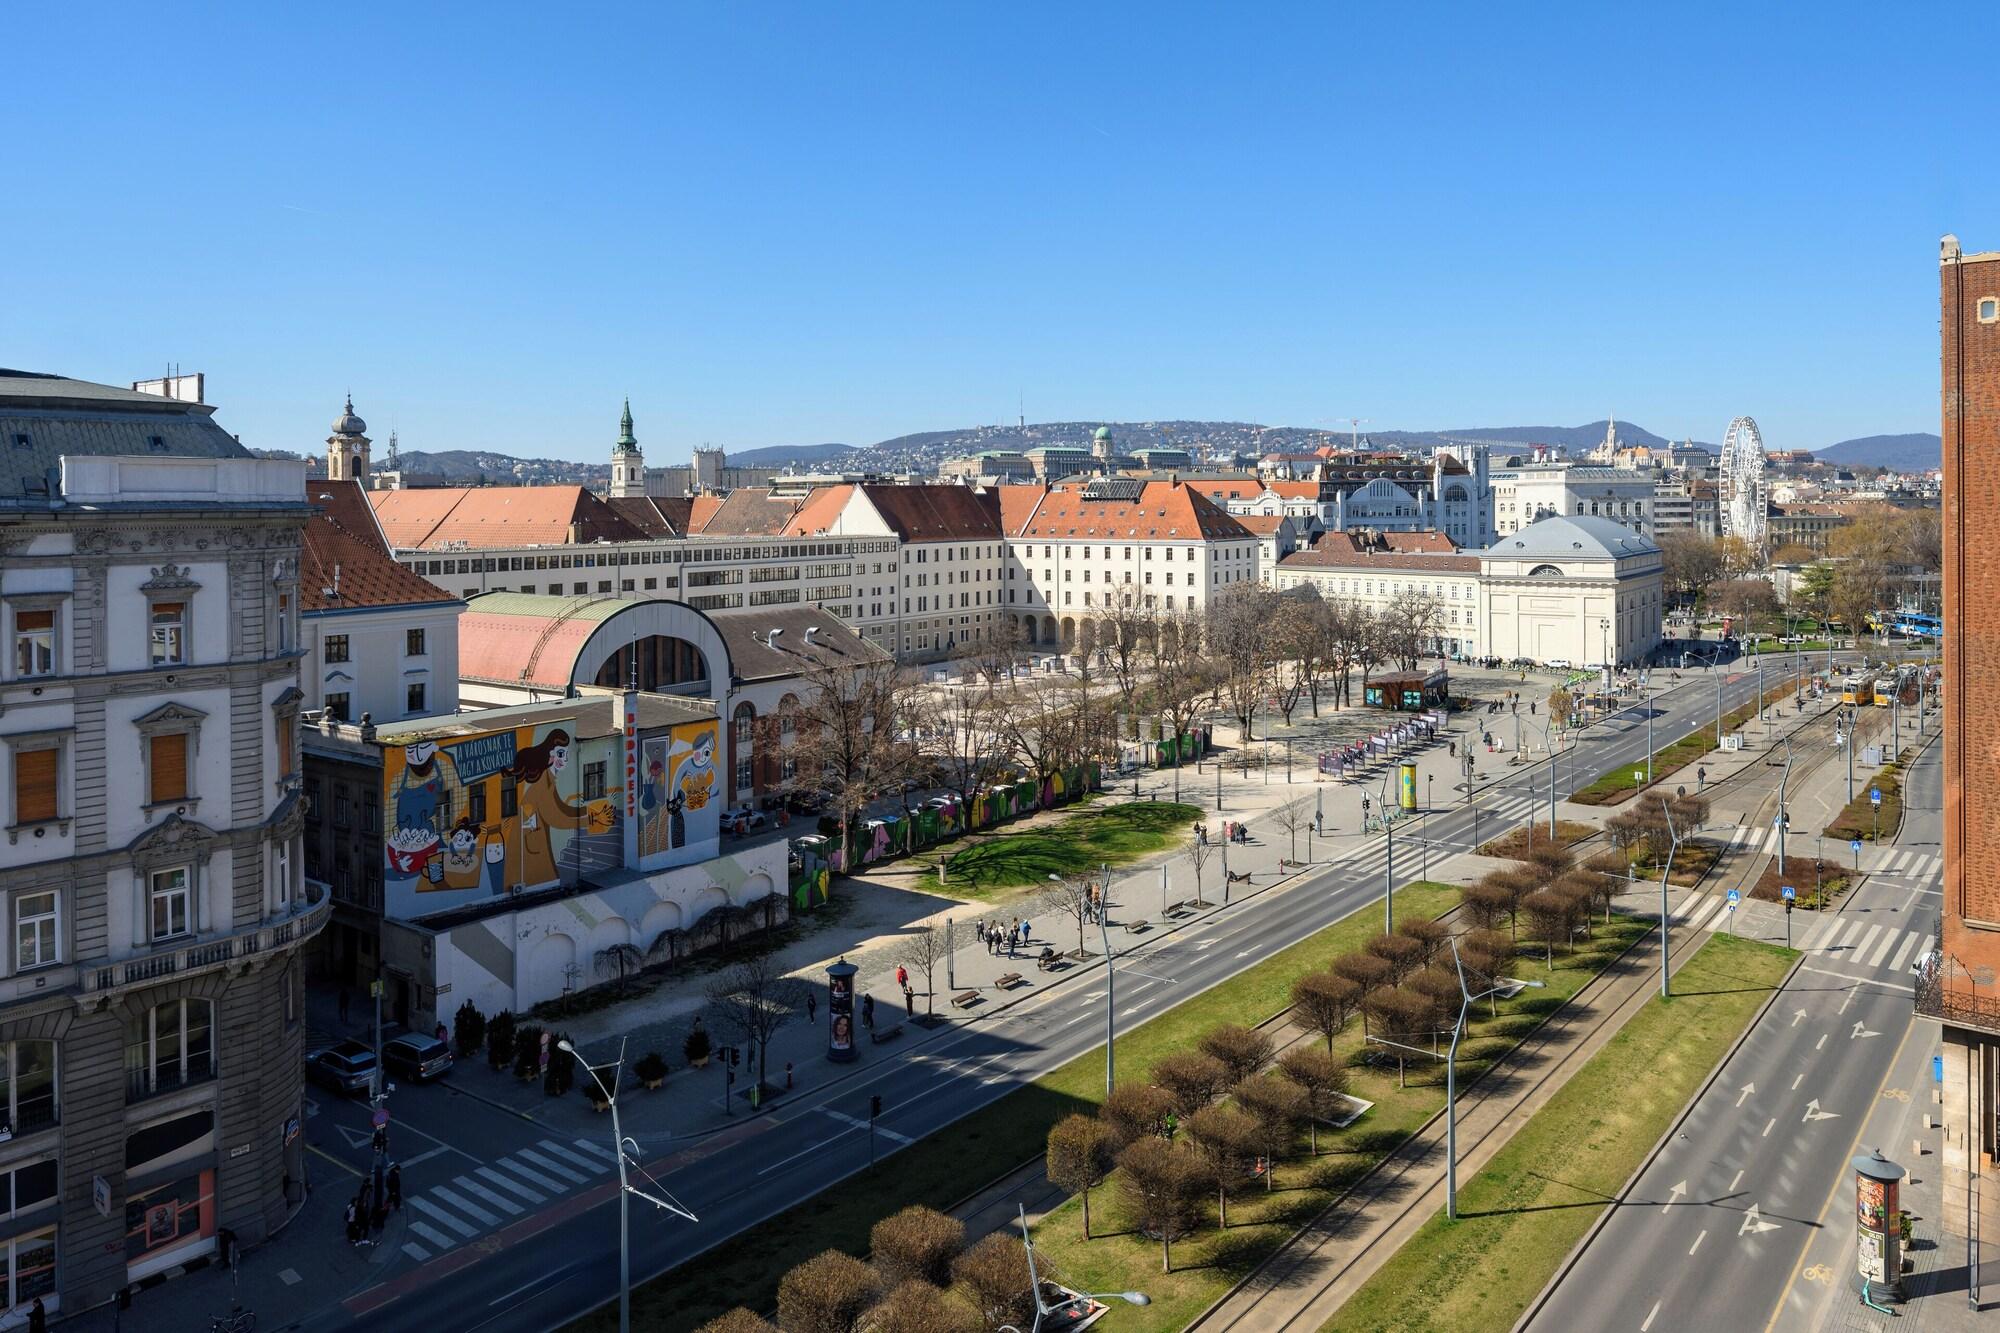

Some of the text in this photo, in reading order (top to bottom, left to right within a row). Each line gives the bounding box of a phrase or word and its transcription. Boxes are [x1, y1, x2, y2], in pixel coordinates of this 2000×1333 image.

[458, 733, 512, 760] A VÁROSNAK TE
[458, 761, 474, 777] VAGY
[626, 713, 636, 817] BUDAPEST
